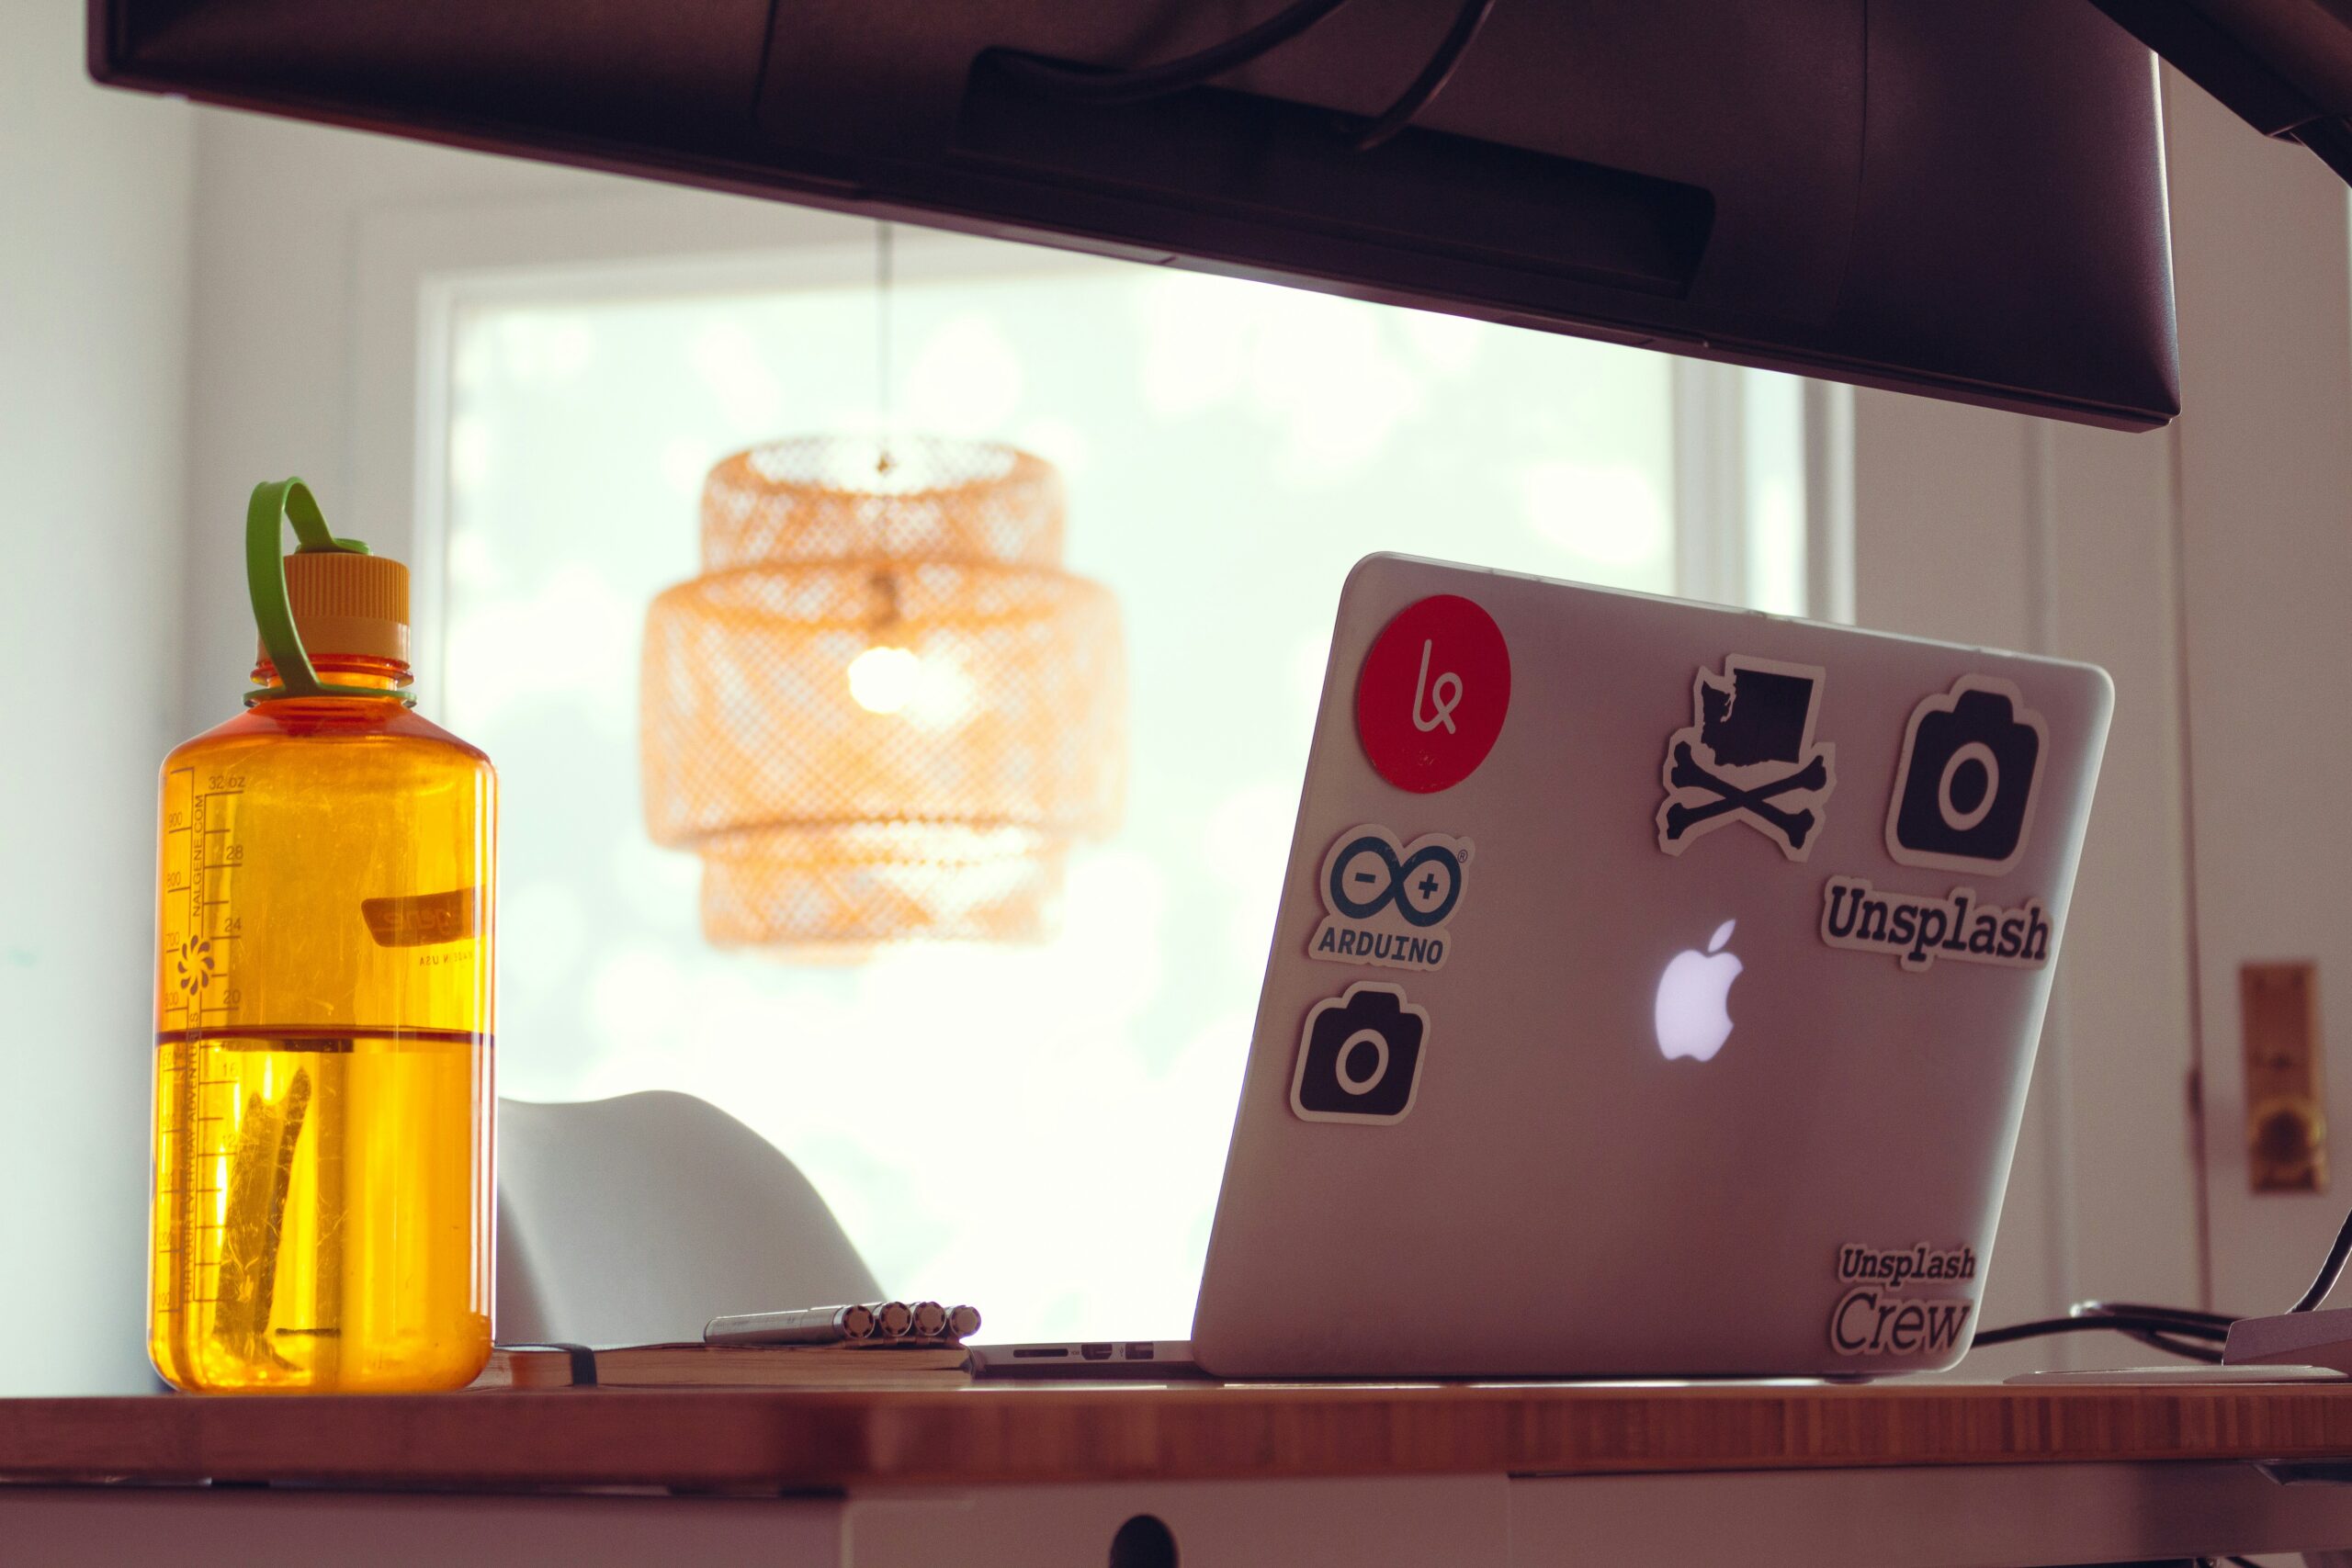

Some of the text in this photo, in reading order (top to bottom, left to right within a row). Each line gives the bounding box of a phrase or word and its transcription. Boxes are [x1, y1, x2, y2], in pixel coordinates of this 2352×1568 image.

[208, 775, 224, 790] 32
[192, 794, 205, 918] NALGENE.COM
[226, 845, 243, 861] 28
[224, 918, 243, 933] 24
[1828, 886, 2049, 963] Unsplash
[1317, 926, 1444, 965] ARDUINO
[223, 989, 242, 1005] 20
[1842, 1247, 1976, 1286] Unsplash
[1836, 1292, 1971, 1349] Crew
